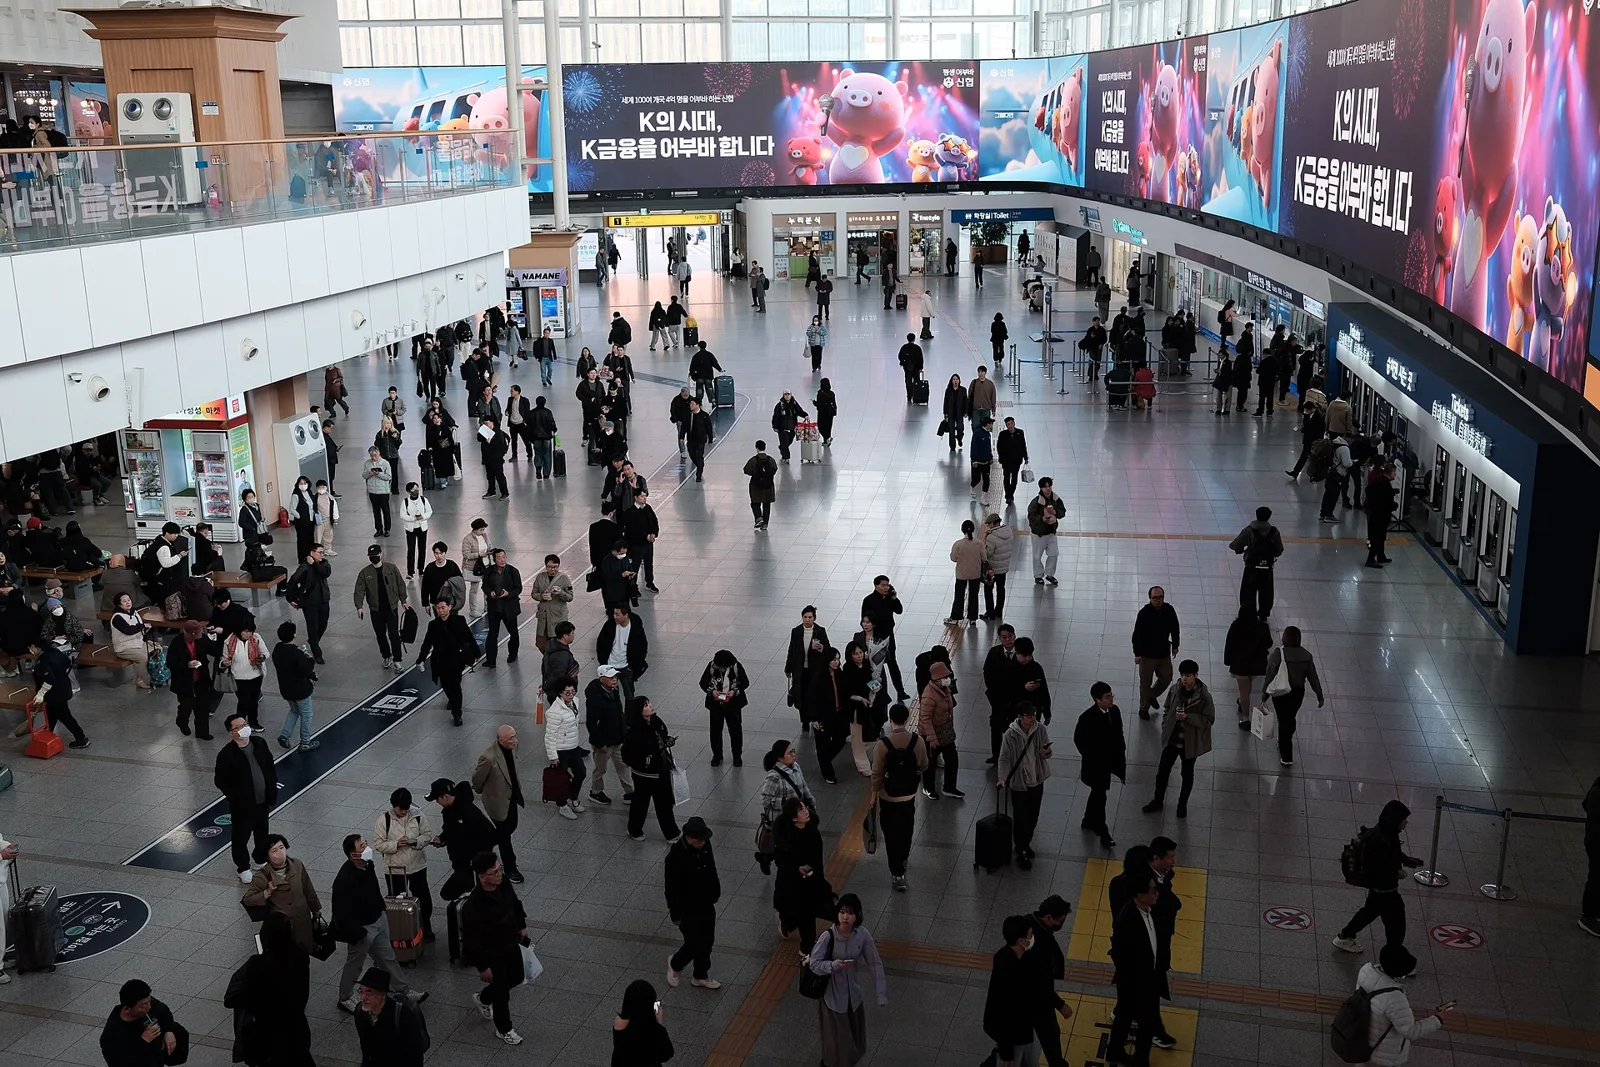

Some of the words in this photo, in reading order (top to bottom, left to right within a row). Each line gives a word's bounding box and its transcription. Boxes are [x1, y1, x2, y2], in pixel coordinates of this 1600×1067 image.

[999, 69, 1014, 77] 신협
[354, 77, 370, 87] 신협
[956, 77, 974, 88] 신협
[690, 95, 708, 103] 어부바
[708, 95, 721, 103] 하는
[1102, 90, 1113, 114] K의
[1113, 89, 1127, 115] 시대,
[639, 110, 675, 132] K의
[678, 110, 722, 134] 시대,
[1333, 88, 1355, 144] K의
[1353, 87, 1380, 152] 시대,
[1102, 119, 1125, 144] K금융을
[581, 136, 657, 160] K금융을
[660, 136, 717, 159] 어부바
[719, 135, 775, 157] 합니다
[1094, 148, 1112, 173] 어부바
[1112, 150, 1130, 175] 합니다
[1294, 156, 1340, 213] K금융을
[1339, 161, 1373, 223] 어부바
[1371, 165, 1413, 236] 합니다
[787, 216, 821, 225] 누리분식
[973, 212, 991, 220] 화장실
[522, 272, 561, 280] NAMANE
[205, 406, 221, 415] 마켓
[1451, 393, 1470, 422] Tickets
